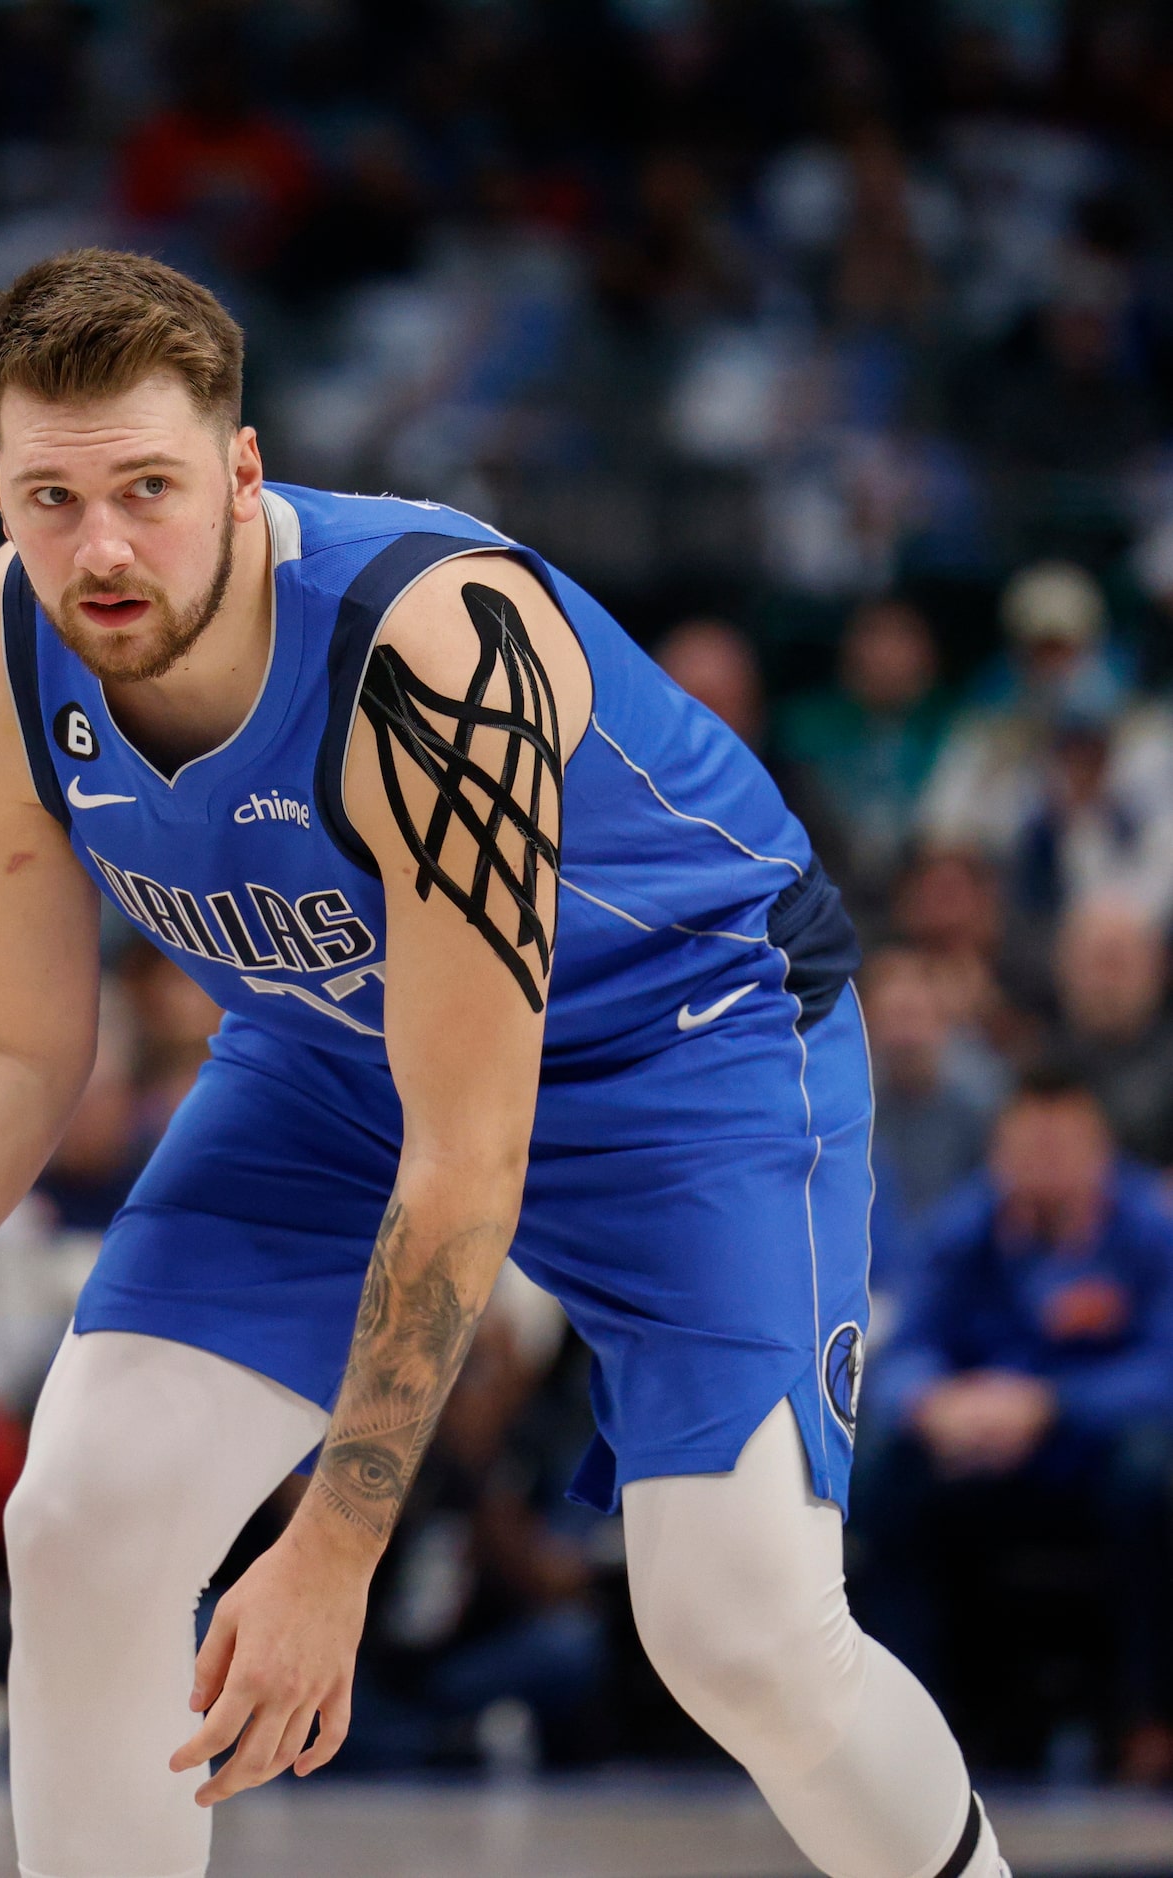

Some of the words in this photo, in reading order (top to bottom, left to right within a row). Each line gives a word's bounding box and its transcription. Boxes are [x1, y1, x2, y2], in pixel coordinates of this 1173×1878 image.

[67, 710, 93, 755] 6
[233, 789, 311, 829] chime
[85, 846, 376, 973] DALLAS
